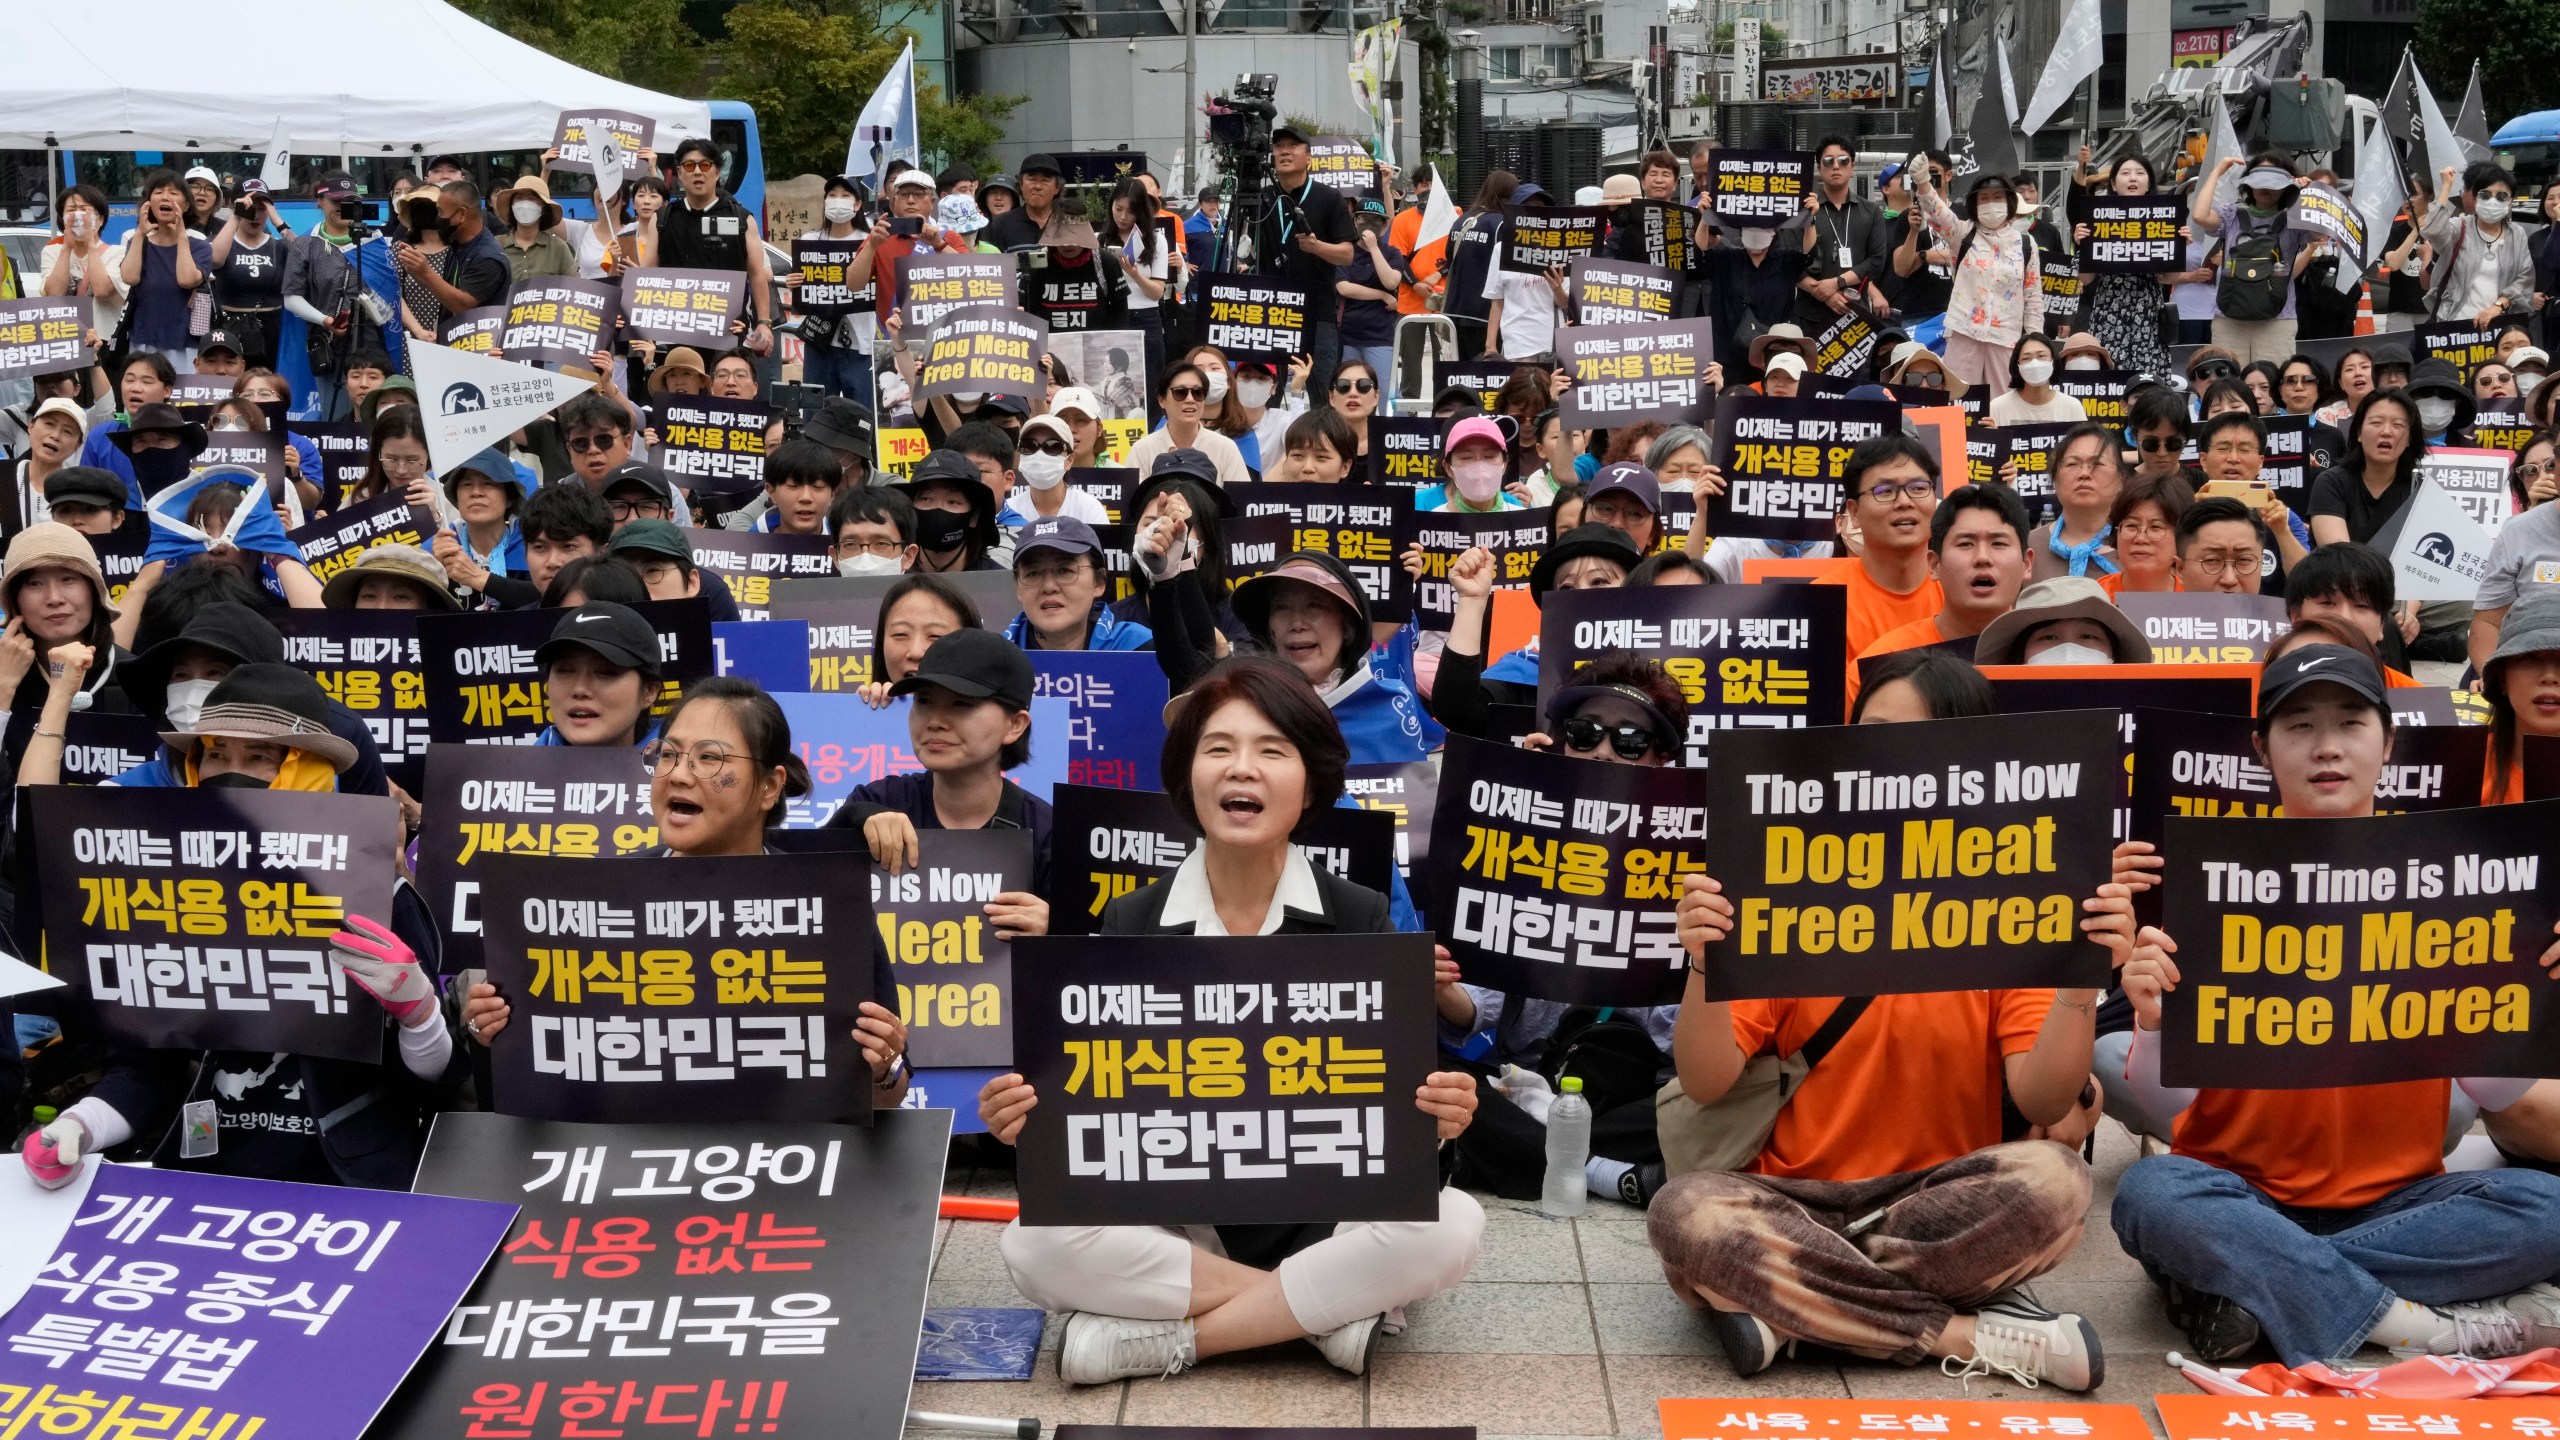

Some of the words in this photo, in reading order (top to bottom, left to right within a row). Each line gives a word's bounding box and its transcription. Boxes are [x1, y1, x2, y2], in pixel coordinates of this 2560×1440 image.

[2176, 34, 2218, 52] 02.2176
[1720, 161, 1750, 172] 이제는
[1753, 162, 1775, 173] 때가
[1777, 162, 1801, 174] 됐다!
[1720, 176, 1764, 192] 개식용
[1770, 177, 1800, 193] 없는
[1717, 195, 1799, 216] 대한민국!
[2094, 208, 2126, 219] 이제는
[2129, 208, 2151, 219] 때가
[2153, 207, 2175, 218] 됐다!
[1516, 216, 1547, 228] 이제는
[1550, 218, 1571, 228] 때가
[1573, 217, 1595, 228] 됐다!
[2094, 222, 2141, 238] 개식용
[2146, 222, 2174, 238] 없는
[1516, 230, 1561, 246] 개식용
[1566, 232, 1592, 246] 없는
[2093, 241, 2174, 261] 대한민국!
[249, 266, 260, 278] 3
[637, 277, 672, 288] 이제는
[675, 279, 700, 290] 때가
[702, 280, 730, 292] 됐다!
[909, 267, 944, 280] 이제는
[947, 266, 972, 277] 때가
[974, 266, 1001, 276] 됐다!
[1584, 270, 1618, 284] 이제는
[1621, 274, 1644, 287] 때가
[1647, 277, 1672, 292] 됐다!
[514, 289, 543, 304] 이제는
[545, 289, 571, 302] 때가
[574, 291, 605, 309] 됐다!
[635, 290, 686, 307] 개식용
[693, 293, 727, 312] 없는
[911, 281, 963, 301] 개식용
[968, 280, 1002, 297] 없는
[1042, 283, 1059, 302] 개
[1063, 282, 1098, 301] 도살
[1212, 286, 1247, 301] 이제는
[1250, 289, 1274, 303] 때가
[1277, 291, 1304, 305] 됐다!
[1584, 286, 1634, 306] 개식용
[1640, 291, 1670, 312] 없는
[510, 304, 557, 323] 개식용
[563, 306, 600, 330] 없는
[631, 308, 725, 336] 대한민국!
[1051, 311, 1087, 328] 금지
[1211, 303, 1263, 324] 개식용
[1269, 307, 1302, 327] 없는
[503, 325, 597, 356] 대한민국!
[933, 326, 952, 342] The
[955, 320, 988, 334] Time
[992, 319, 1005, 332] is
[1008, 321, 1037, 340] Now
[1208, 325, 1301, 353] 대한민국!
[933, 335, 981, 360] Dog
[982, 335, 1028, 359] Meat
[1575, 340, 1620, 354] 이제는
[1624, 337, 1655, 351] 때가
[1658, 334, 1693, 349] 됐다!
[923, 362, 965, 384] Free
[970, 358, 1034, 383] Korea
[1577, 356, 1643, 380] 개식용
[1650, 354, 1695, 376] 없는
[1578, 379, 1696, 411] 대한민국!
[668, 408, 706, 424] 이제는
[709, 411, 735, 426] 때가
[738, 414, 767, 429] 됐다!
[1736, 418, 1793, 439] 이제는
[1798, 421, 1837, 441] 때가
[667, 425, 723, 449] 개식용
[729, 431, 764, 452] 없는
[664, 449, 764, 480] 대한민국!
[1735, 445, 1819, 476] 개식용
[693, 549, 747, 570] 이제는
[751, 553, 787, 572] 때가
[791, 555, 832, 573] 됐다!
[1575, 620, 1661, 649] 이제는
[1671, 619, 1731, 648] 때가
[1739, 619, 1808, 649] 됐다!
[1720, 658, 1809, 704] 없는
[1746, 774, 1823, 814] The
[1834, 771, 1937, 811] Time
[1948, 765, 1984, 806] is
[1995, 761, 2080, 803] Now
[1470, 780, 1564, 828] 이제는
[1572, 798, 1643, 837] 때가
[74, 828, 172, 866] 이제는
[181, 831, 251, 868] 때가
[260, 832, 348, 870] 됐다!
[1463, 826, 1608, 895] 개식용
[1766, 827, 1884, 888] Dog
[1903, 817, 2056, 878] Meat
[2202, 862, 2280, 903] The
[2291, 864, 2396, 903] Time
[2407, 859, 2443, 899] is
[2454, 854, 2538, 896] Now
[80, 878, 227, 934] 개식용
[240, 881, 343, 937] 없는
[524, 898, 635, 938] 이제는
[646, 901, 724, 937] 때가
[734, 897, 822, 937] 됐다!
[1741, 898, 1874, 954] Free
[1892, 892, 2073, 950] Korea
[2222, 915, 2342, 980] Dog
[2361, 909, 2515, 971] Meat
[86, 944, 349, 1014] 대한민국!
[528, 949, 694, 1005] 개식용
[711, 950, 826, 1004] 없는
[1061, 985, 1183, 1025] 이제는
[1195, 984, 1278, 1024] 때가
[1288, 981, 1382, 1023] 됐다!
[2198, 986, 2333, 1045] Free
[2350, 984, 2529, 1042] Korea
[532, 1015, 825, 1082] 대한민국!
[1064, 1038, 1246, 1097] 개식용
[1264, 1036, 1385, 1094] 없는
[1067, 1107, 1384, 1181] 대한민국!
[523, 1147, 597, 1204] 개
[612, 1141, 841, 1201] 고양이
[74, 1195, 165, 1244] 개
[156, 1204, 401, 1273] 고양이
[503, 1217, 656, 1278] 식용
[675, 1213, 826, 1274] 없는
[36, 1247, 177, 1311] 식용
[186, 1272, 353, 1335] 종식
[446, 1293, 839, 1358] 대한민국을
[8, 1306, 258, 1390] 특별법
[1718, 1413, 1809, 1430] 사육
[1860, 1415, 1949, 1432] 도살
[2223, 1412, 2316, 1431] 사육
[2367, 1415, 2461, 1434] 도살
